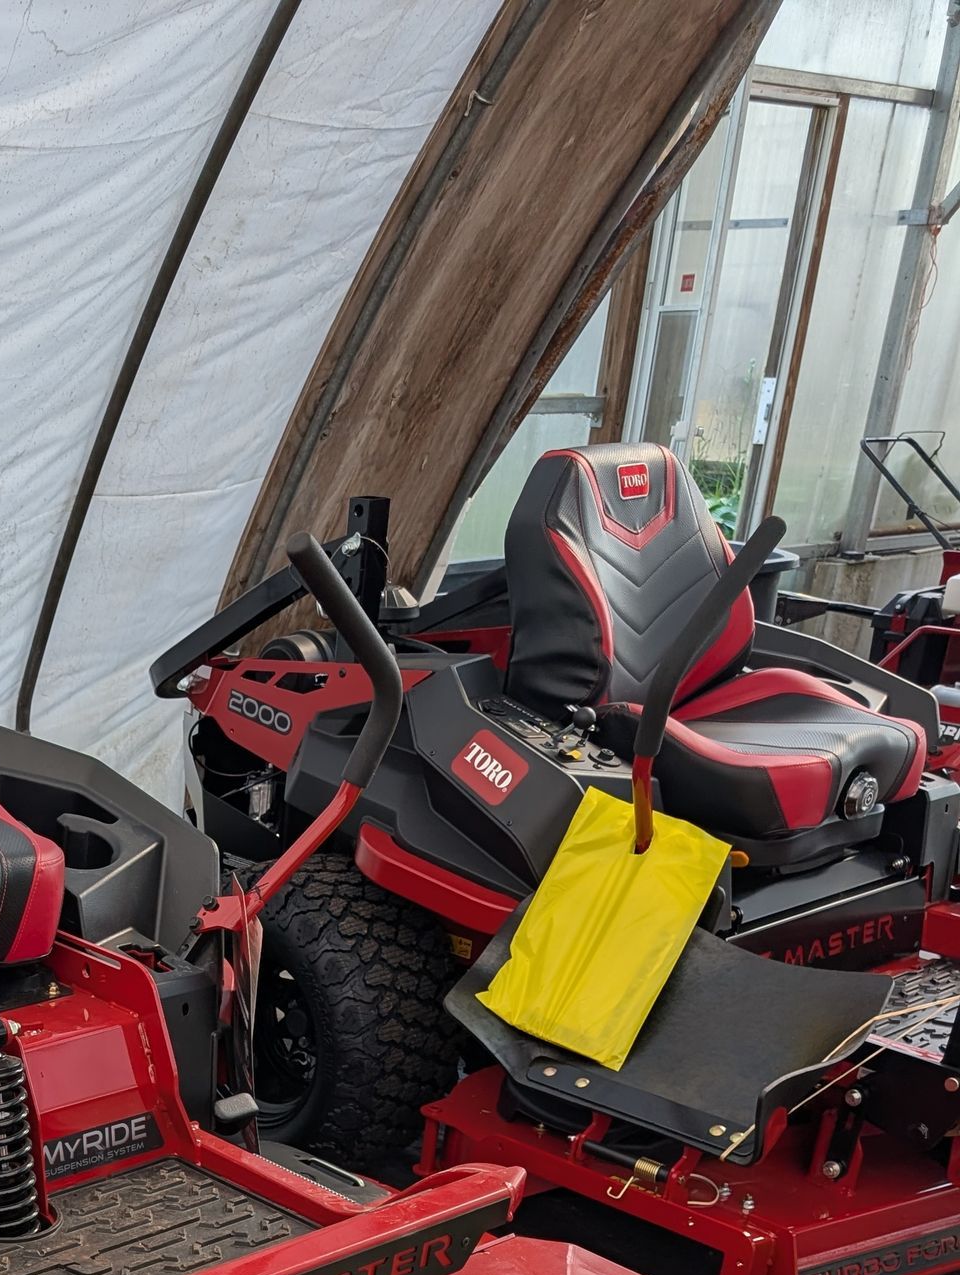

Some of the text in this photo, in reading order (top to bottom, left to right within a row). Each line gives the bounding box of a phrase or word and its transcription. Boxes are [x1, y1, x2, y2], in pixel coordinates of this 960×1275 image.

[621, 473, 647, 489] TORO
[228, 689, 292, 733] 2000
[783, 914, 895, 966] MASTER
[44, 1142, 145, 1178] SUSPENSION SYSTEM
